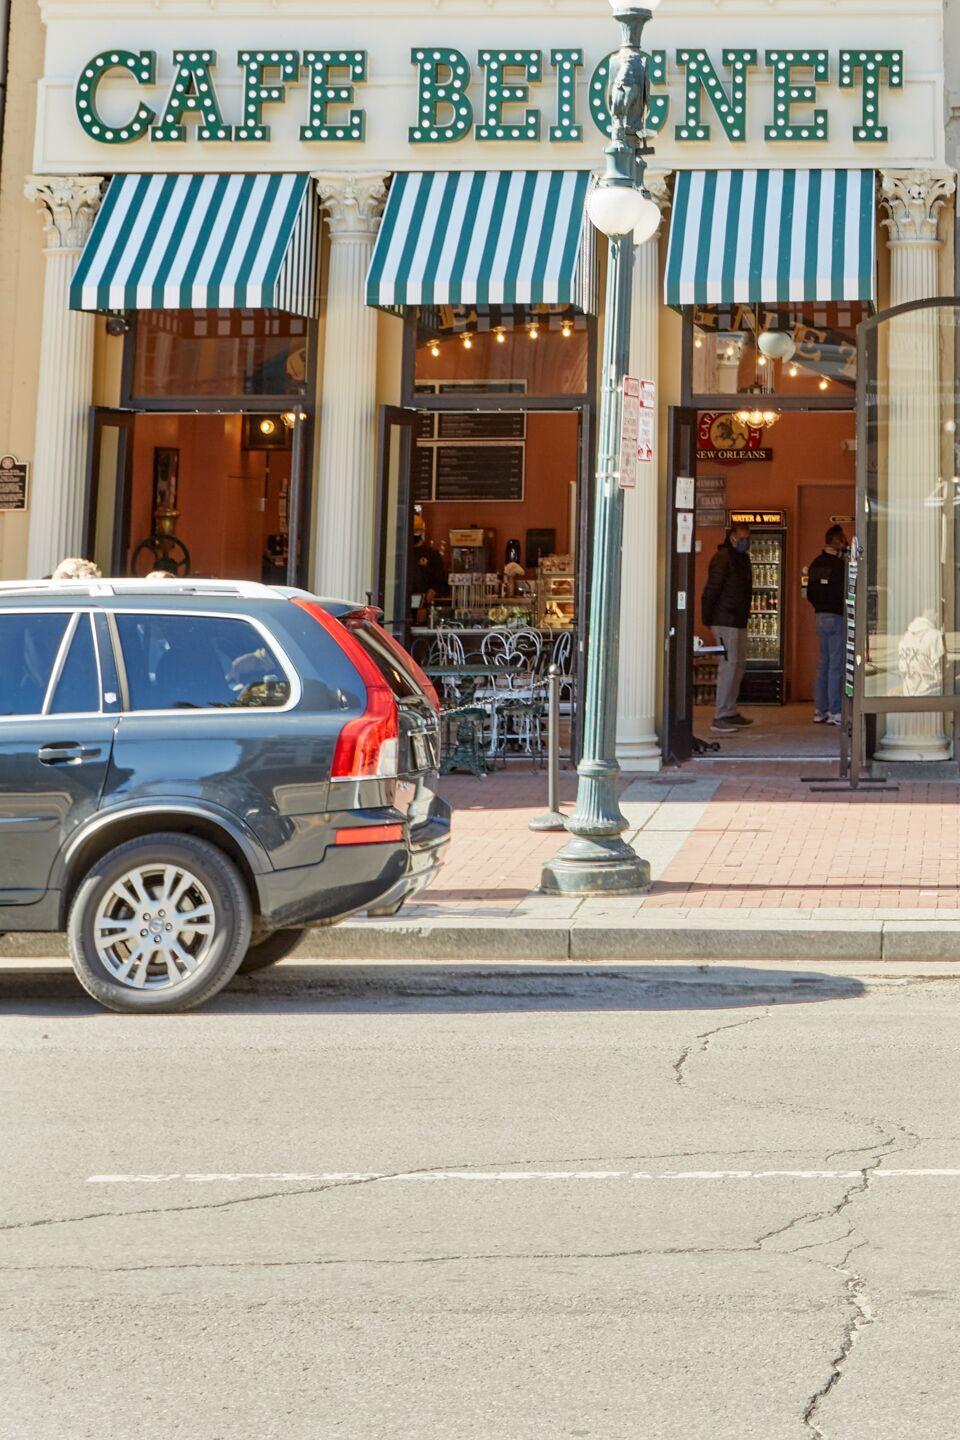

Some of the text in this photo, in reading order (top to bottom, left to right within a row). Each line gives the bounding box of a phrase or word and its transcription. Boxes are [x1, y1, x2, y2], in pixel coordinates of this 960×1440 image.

[74, 47, 904, 144] CAFE BEIGNET
[718, 450, 766, 459] ORLEANS
[731, 514, 754, 523] WATER
[763, 514, 781, 523] WINE
